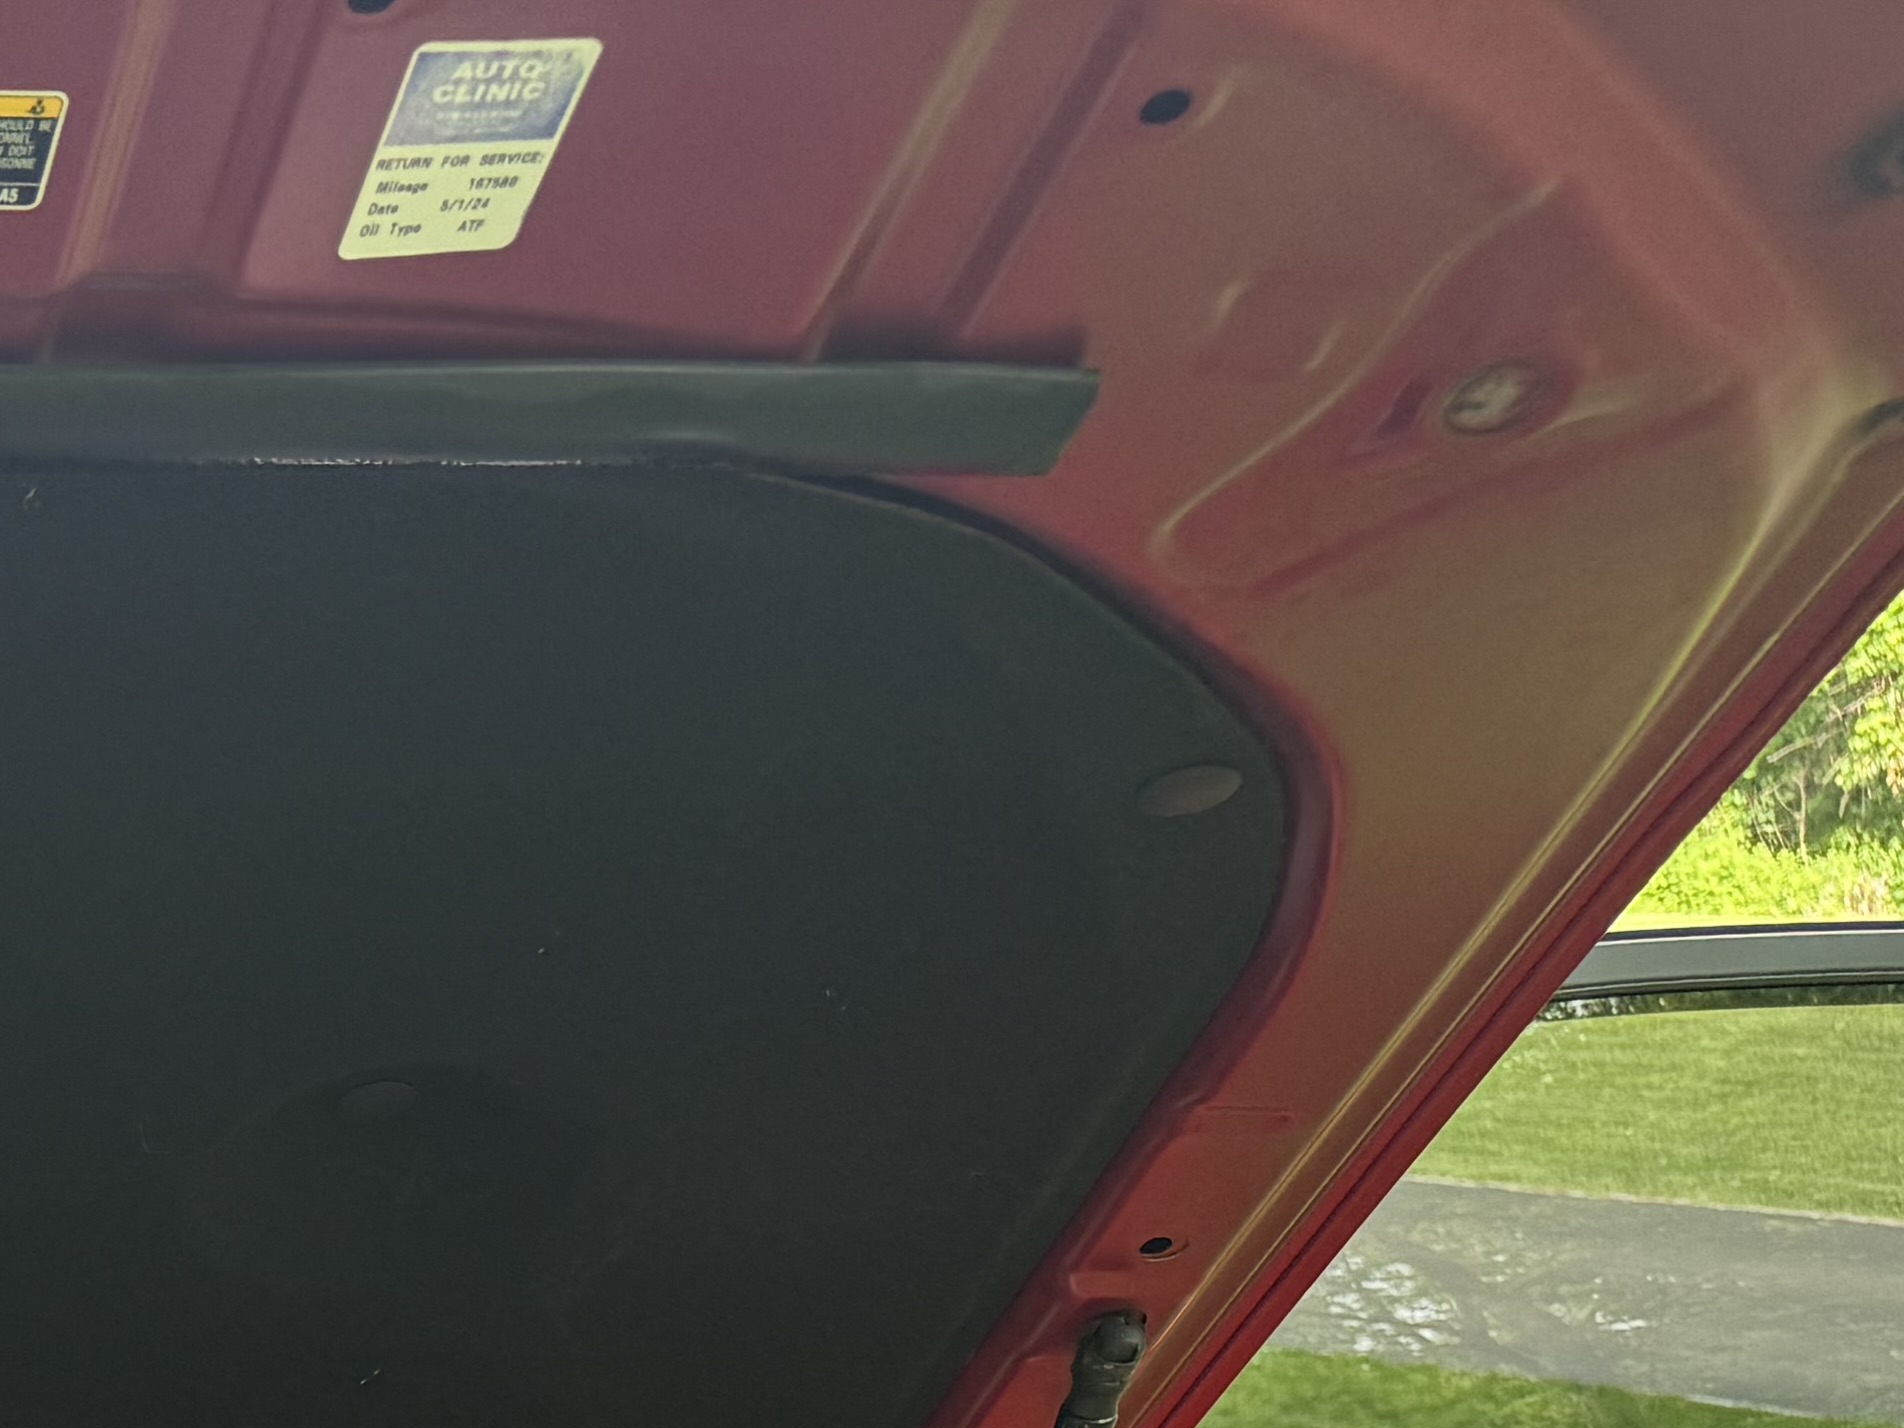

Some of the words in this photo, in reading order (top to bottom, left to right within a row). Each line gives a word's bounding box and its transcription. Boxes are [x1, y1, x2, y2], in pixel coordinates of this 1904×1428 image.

[450, 57, 544, 81] AUTO
[433, 80, 547, 104] CLINIC
[7, 144, 34, 158] DOIT
[376, 156, 433, 171] RETURN
[441, 154, 471, 168] FOR
[376, 180, 429, 195] Mileage
[367, 202, 400, 216] Date
[360, 223, 380, 237] Oil
[389, 222, 422, 238] Type
[456, 219, 486, 233] ATF
